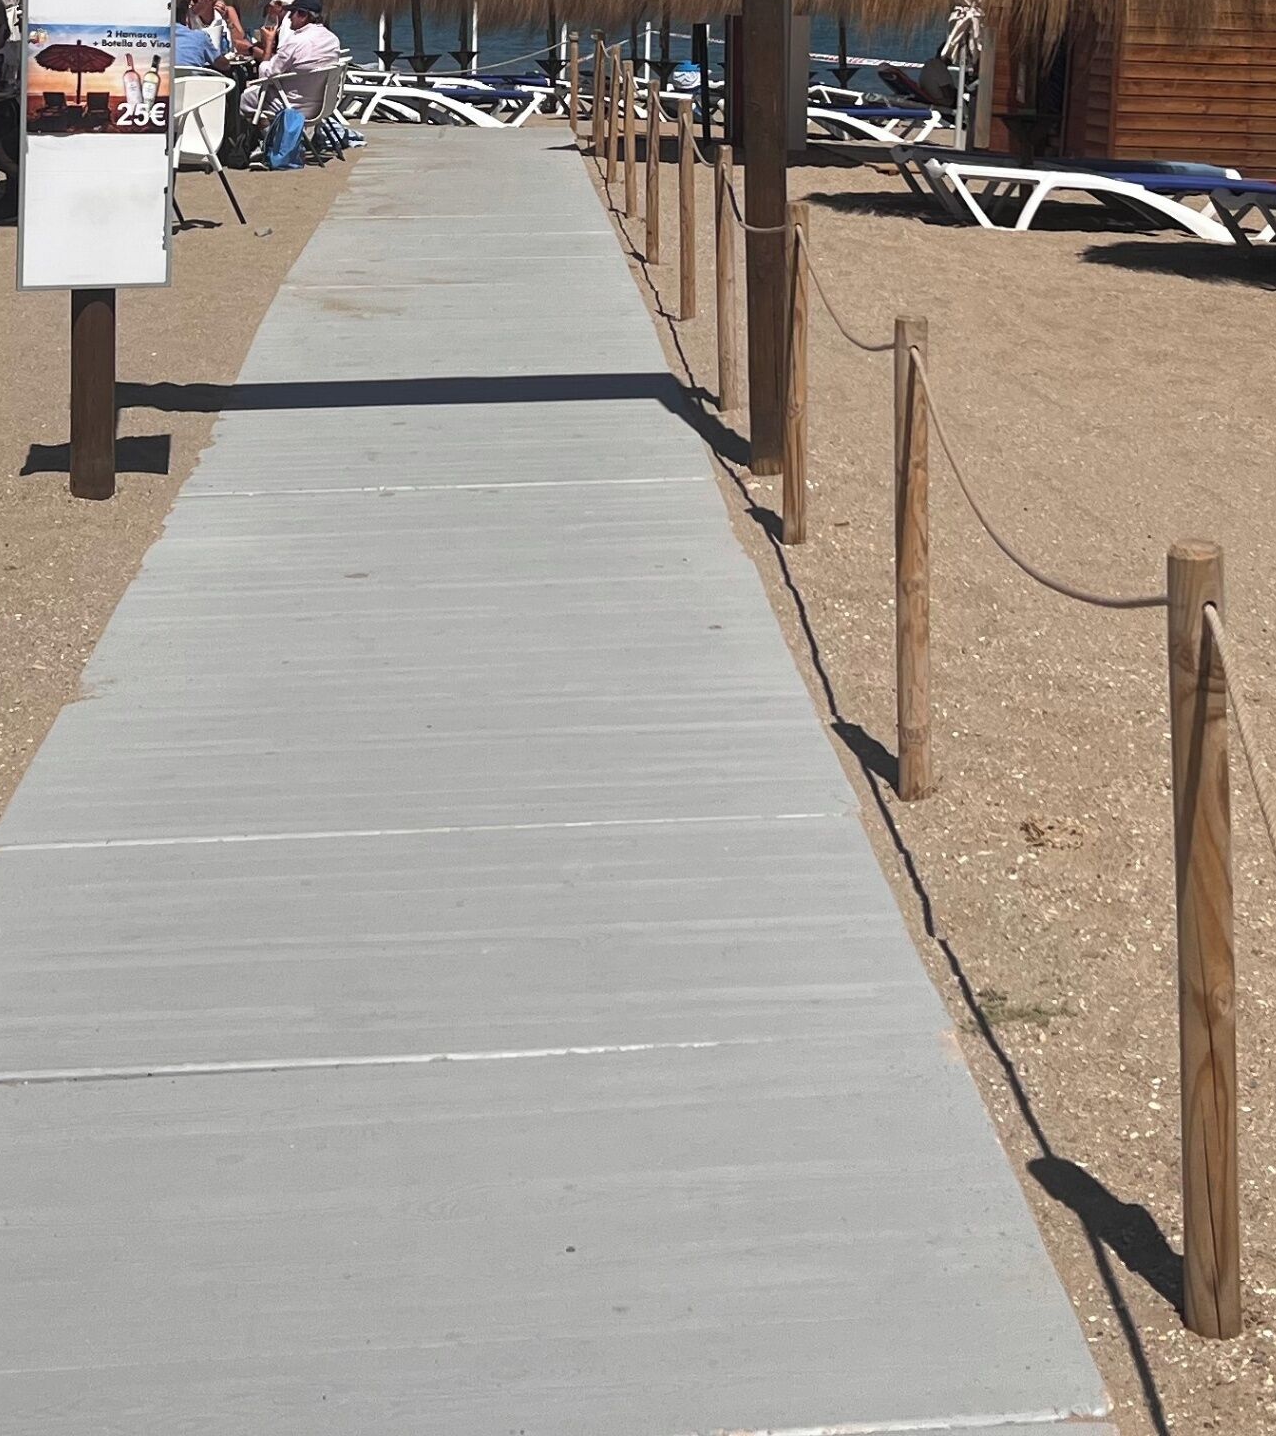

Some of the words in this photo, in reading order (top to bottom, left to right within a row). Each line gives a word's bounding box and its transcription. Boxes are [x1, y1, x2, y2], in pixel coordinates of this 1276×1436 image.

[107, 30, 112, 38] 2
[115, 30, 158, 38] Hamacas
[102, 39, 133, 47] Botella
[135, 39, 148, 47] de
[150, 40, 171, 48] Vino
[116, 102, 166, 126] 25€
